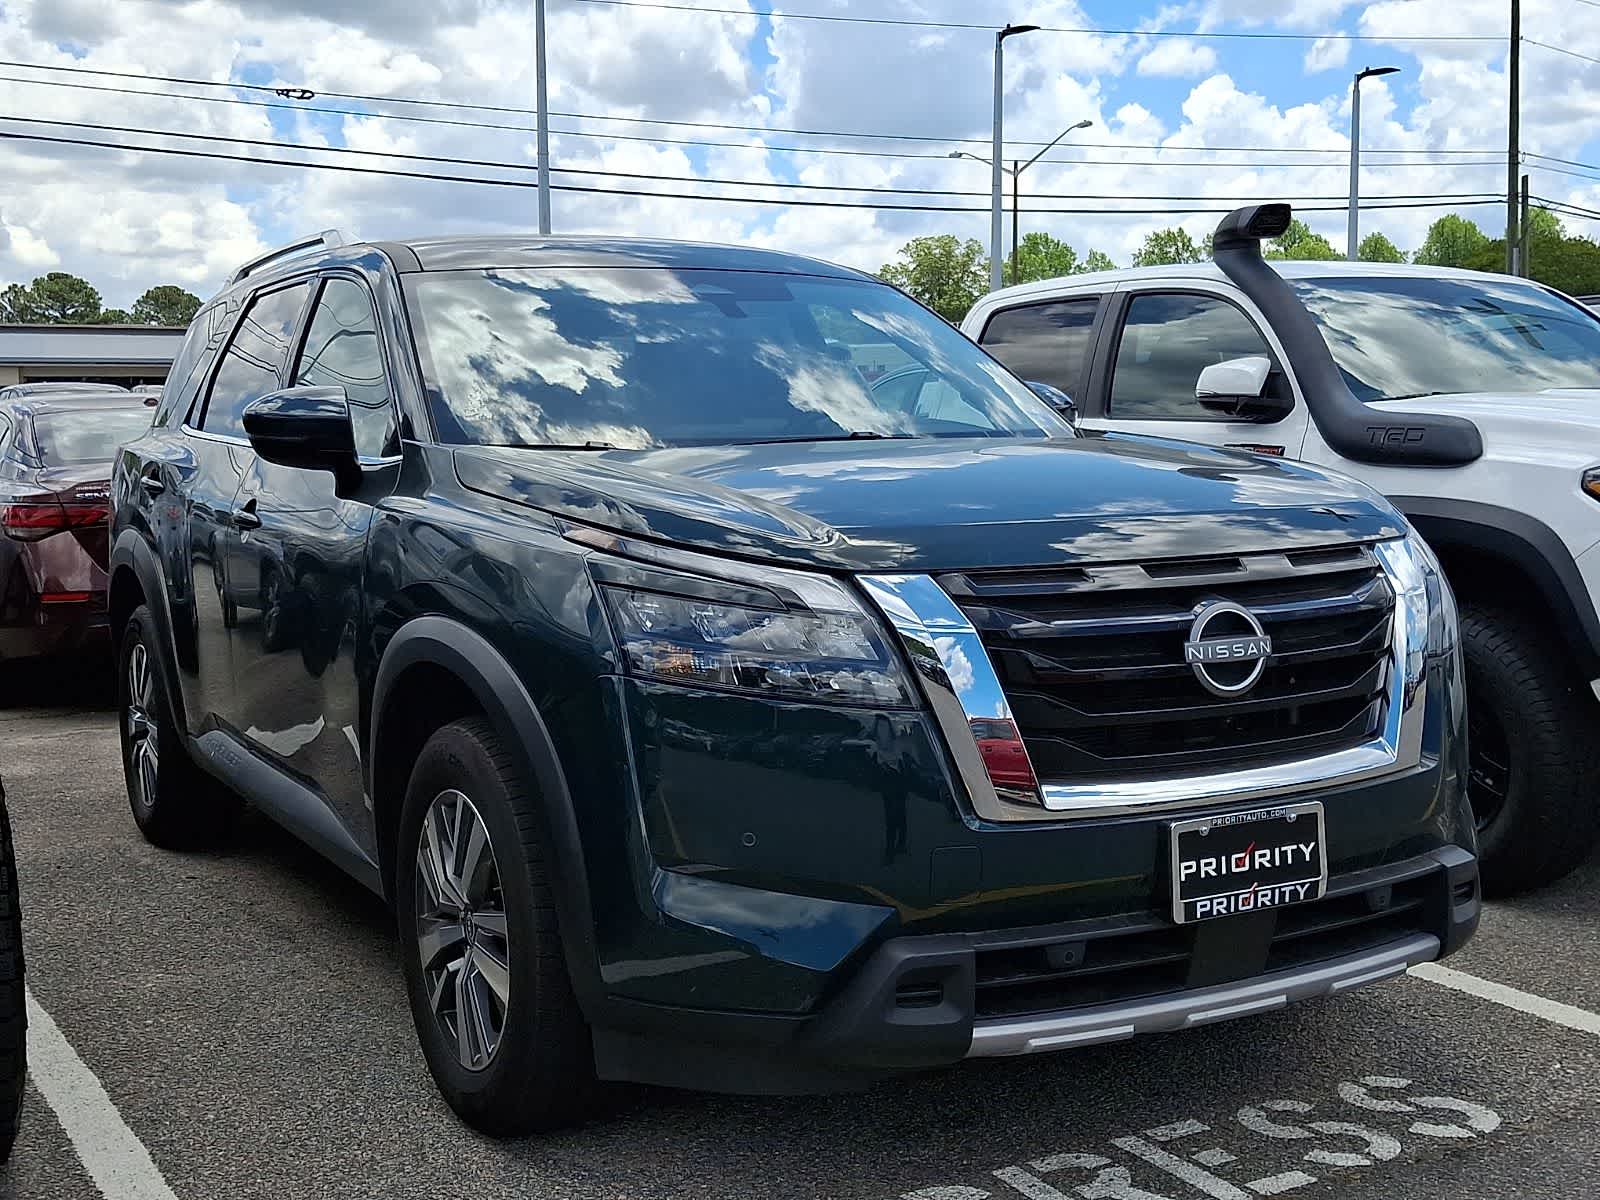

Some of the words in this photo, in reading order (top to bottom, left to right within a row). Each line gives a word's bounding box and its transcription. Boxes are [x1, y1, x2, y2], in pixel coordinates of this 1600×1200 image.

[1366, 426, 1425, 448] TRD
[1188, 641, 1271, 660] NISSAN
[1212, 808, 1287, 826] PRIORITYAUTO.COM
[1180, 842, 1316, 882] PRIORITY
[1196, 883, 1310, 918] PRIORITY
[900, 1075, 1501, 1200] RESS
